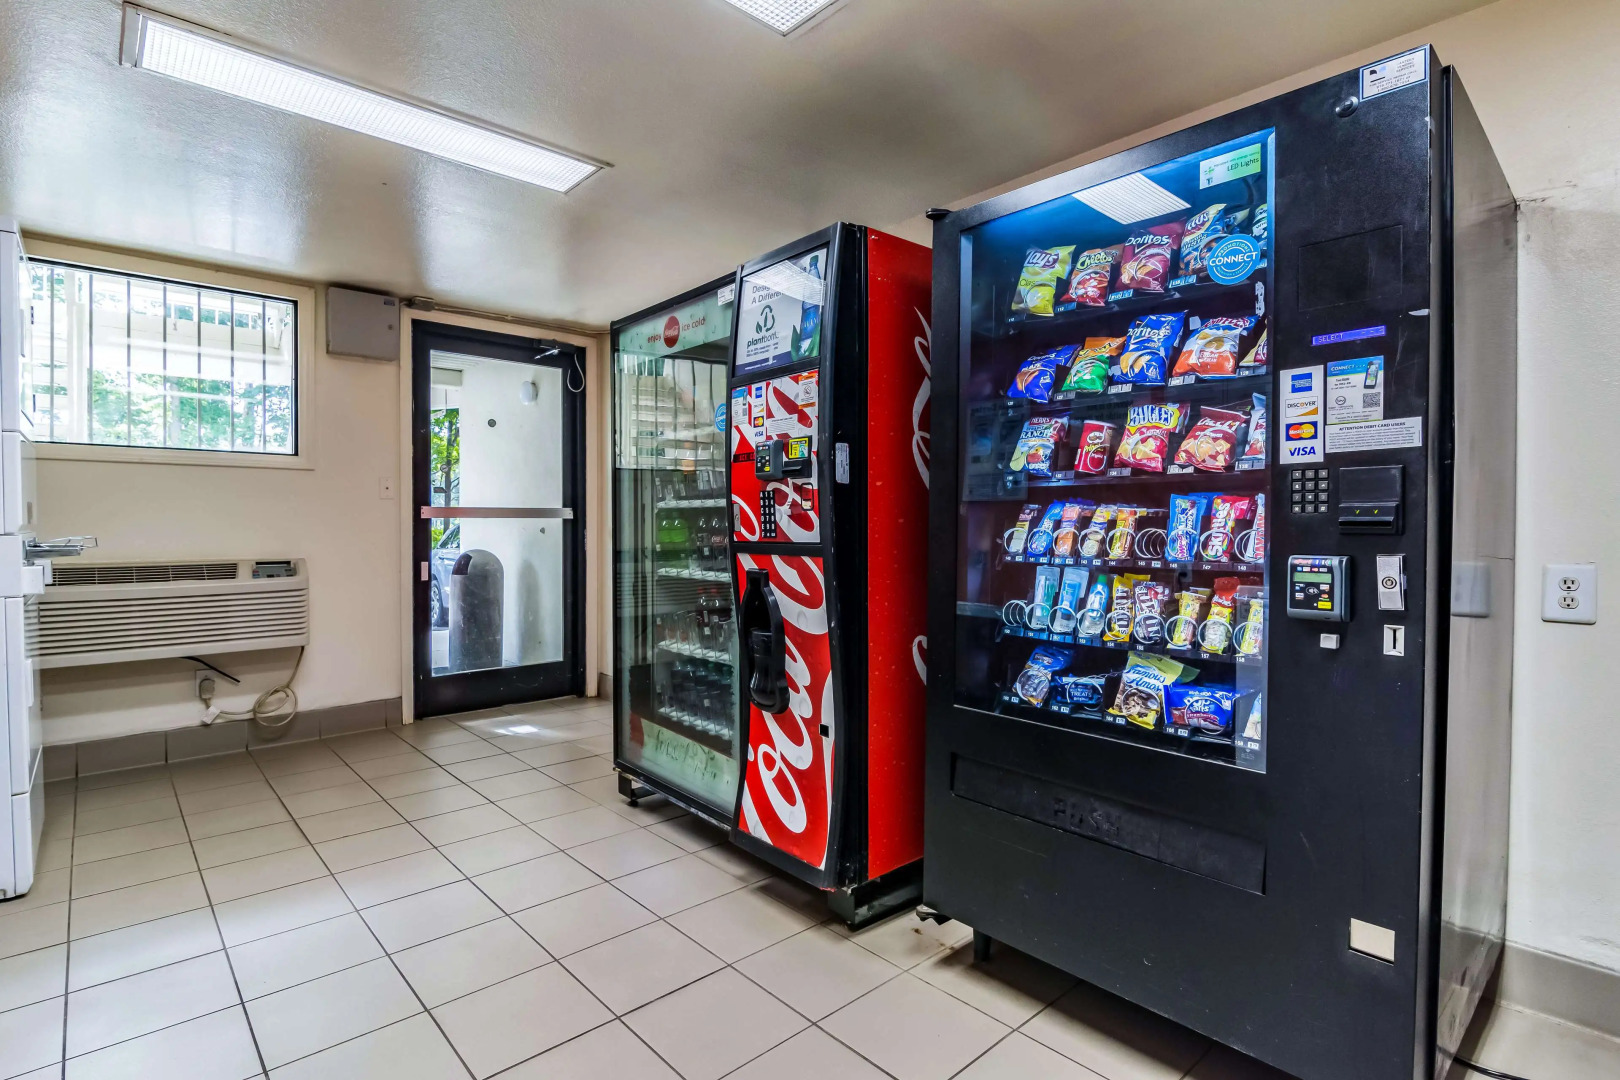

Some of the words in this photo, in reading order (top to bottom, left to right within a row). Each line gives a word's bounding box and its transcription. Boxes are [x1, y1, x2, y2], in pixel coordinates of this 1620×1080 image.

[1227, 163, 1239, 172] LED
[1240, 157, 1260, 168] Lights
[1125, 233, 1170, 247] Doritos
[1024, 249, 1059, 268] Lay's
[1209, 251, 1259, 266] CONNECT
[751, 297, 757, 305] A
[647, 333, 662, 344] enjoy
[681, 323, 691, 333] ice
[691, 316, 706, 329] cold
[1318, 333, 1344, 343] SELECT
[1330, 364, 1355, 372] CONNECT
[1287, 400, 1316, 409] DISCOVER
[1128, 403, 1174, 427] BUGLES
[1288, 446, 1316, 457] VISA
[1124, 664, 1167, 684] Famous
[1126, 676, 1162, 693] Amos
